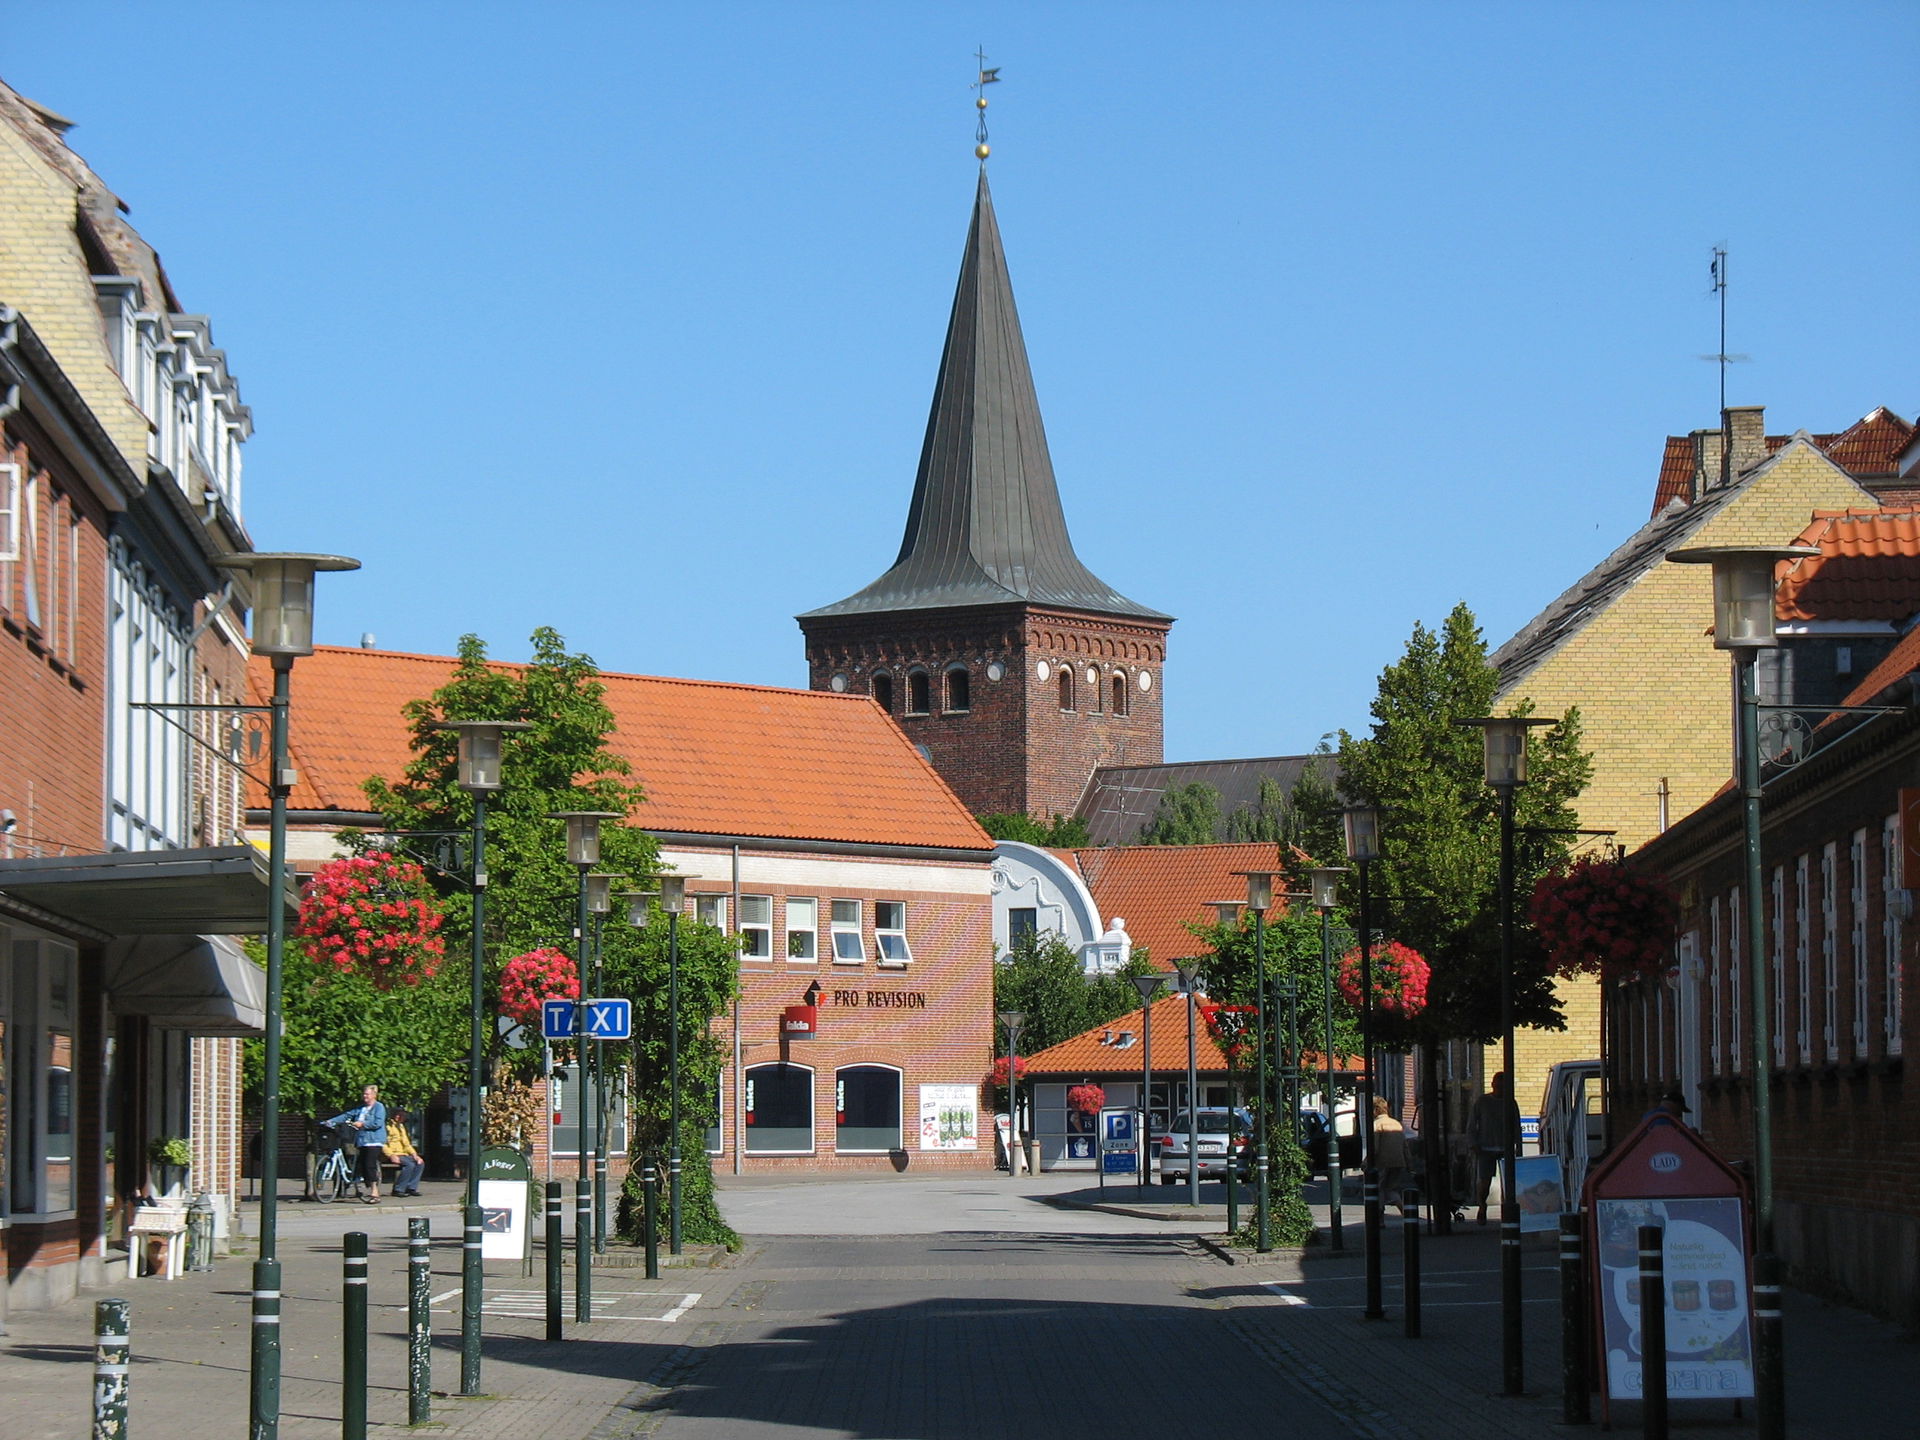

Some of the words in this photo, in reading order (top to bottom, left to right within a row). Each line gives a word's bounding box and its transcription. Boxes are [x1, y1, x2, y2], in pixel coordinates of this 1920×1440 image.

[834, 990, 859, 1007] PRO
[867, 991, 925, 1008] REVISION
[548, 1006, 622, 1031] TAXI
[786, 1021, 809, 1030] falda
[1112, 1117, 1127, 1138] P
[1652, 1157, 1678, 1168] LADY
